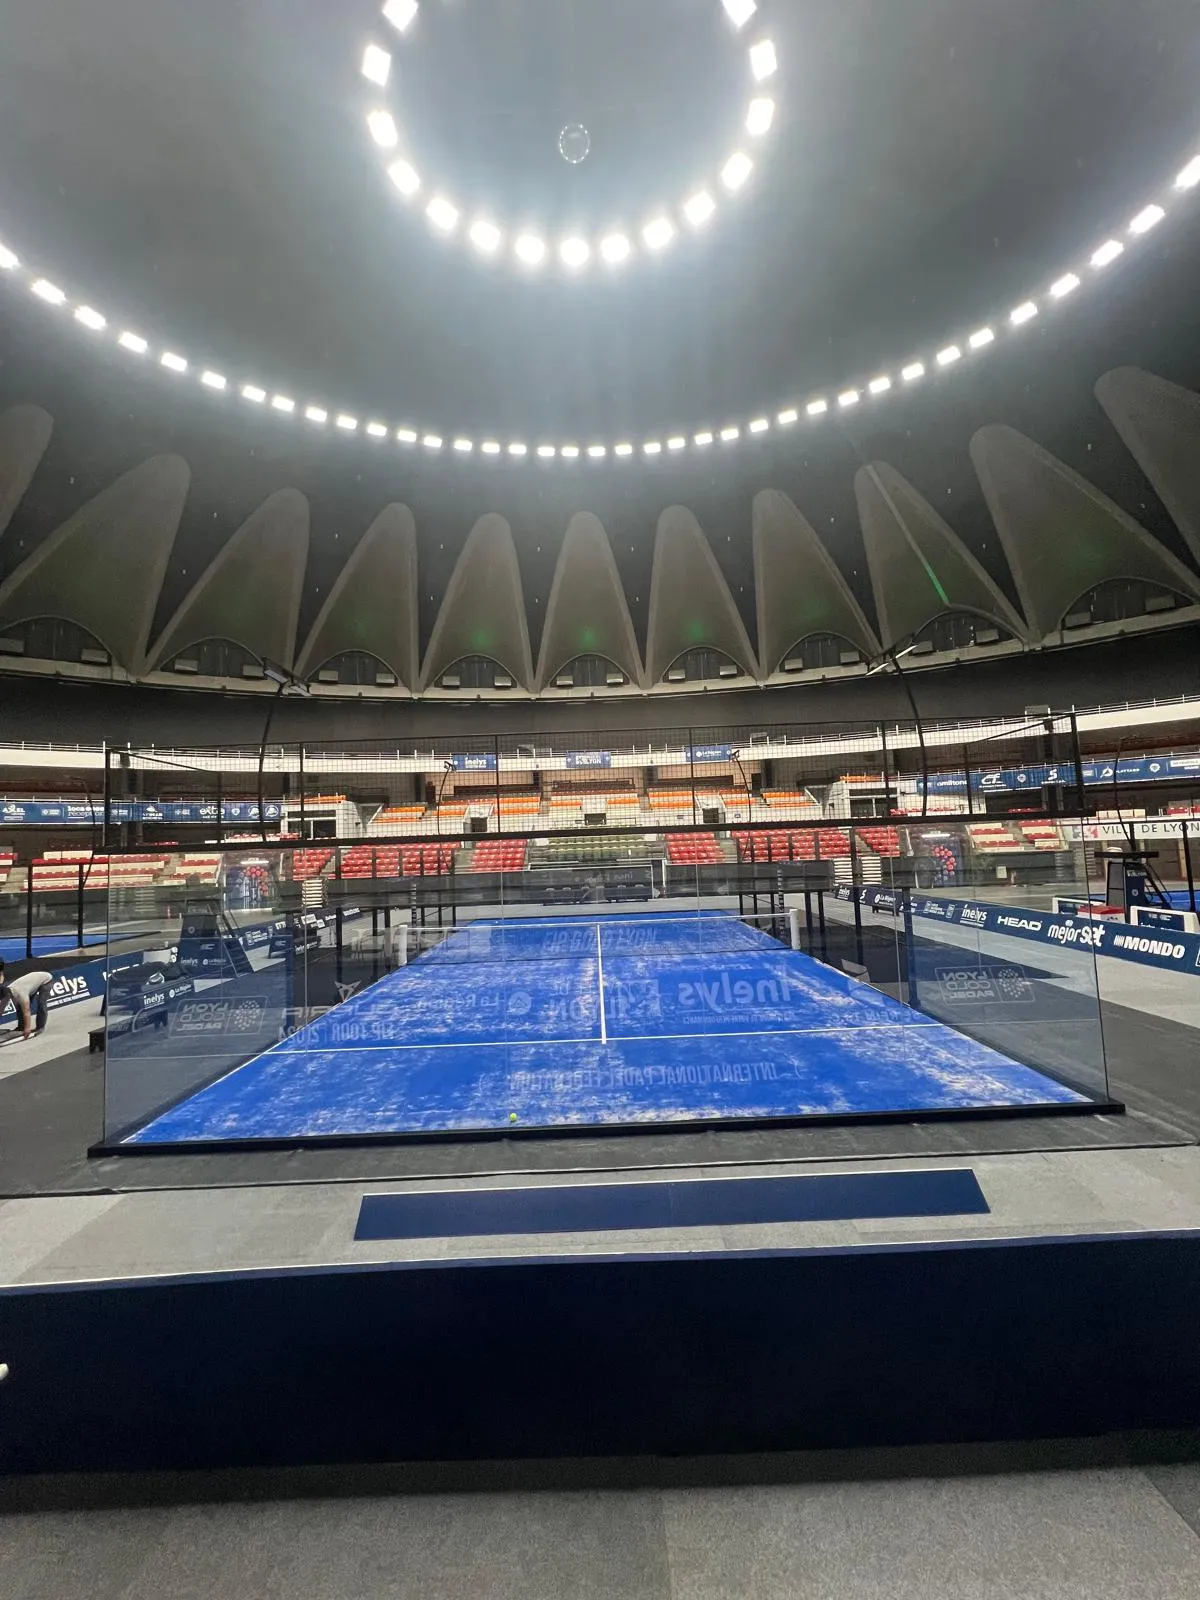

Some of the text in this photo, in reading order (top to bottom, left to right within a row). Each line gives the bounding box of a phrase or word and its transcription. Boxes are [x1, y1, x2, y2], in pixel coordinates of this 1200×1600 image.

[1141, 824, 1158, 833] DE
[997, 915, 1042, 931] HEAD
[1123, 935, 1186, 959] MONDO
